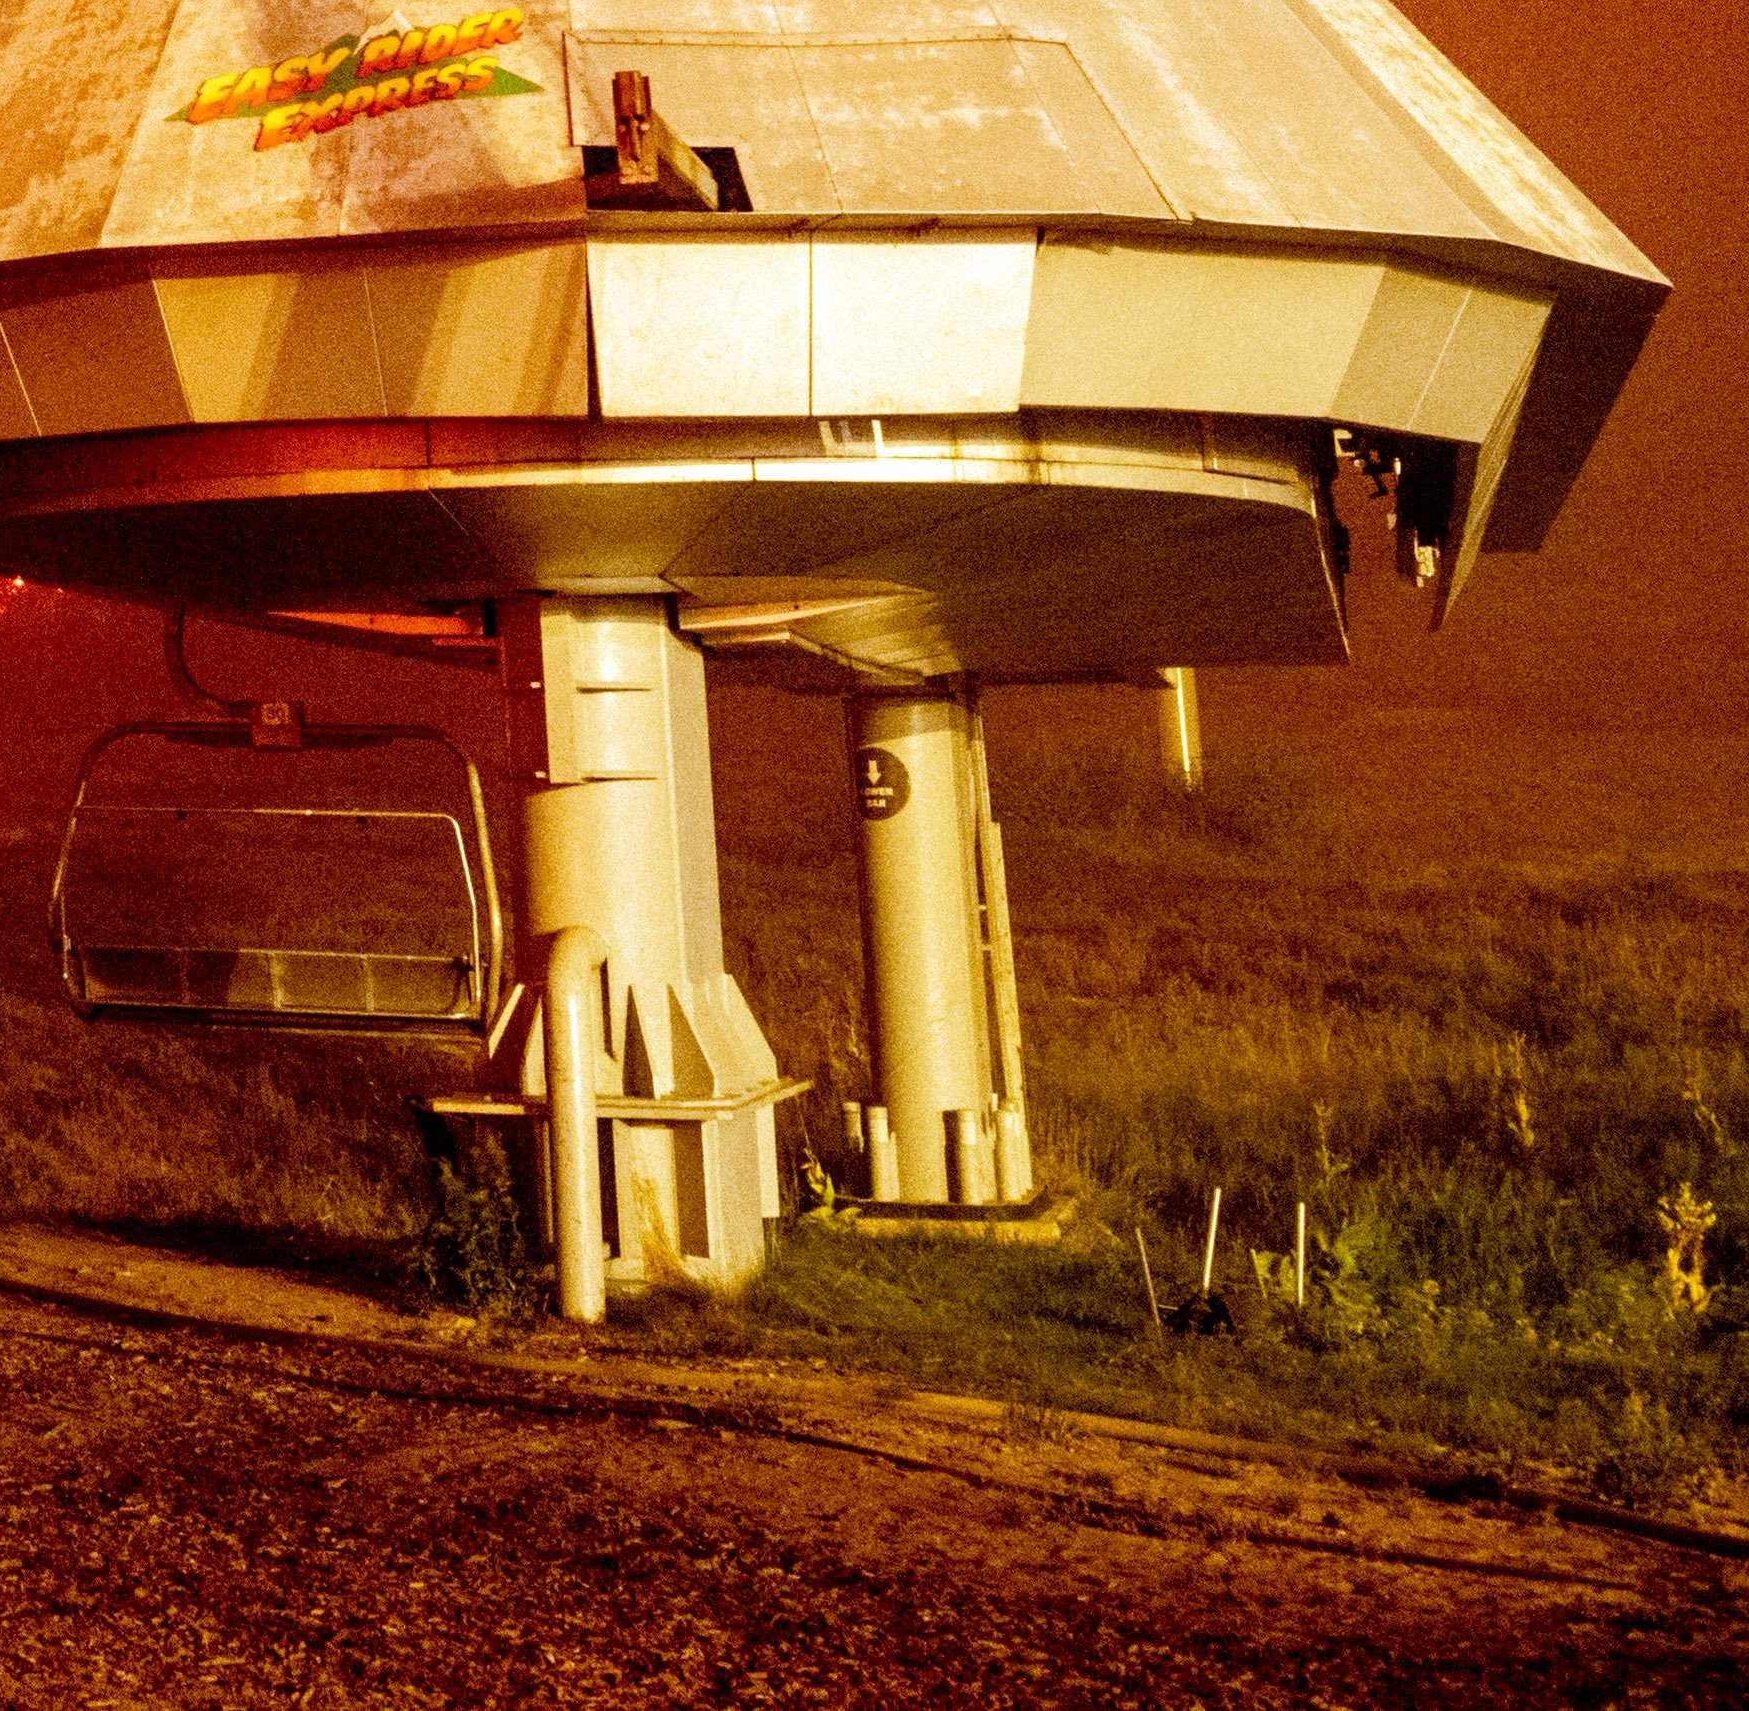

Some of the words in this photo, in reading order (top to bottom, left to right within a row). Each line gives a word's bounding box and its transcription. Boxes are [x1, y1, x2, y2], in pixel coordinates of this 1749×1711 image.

[186, 46, 352, 125] EASY
[357, 7, 524, 79] RIDER
[253, 55, 499, 152] EXPRESS
